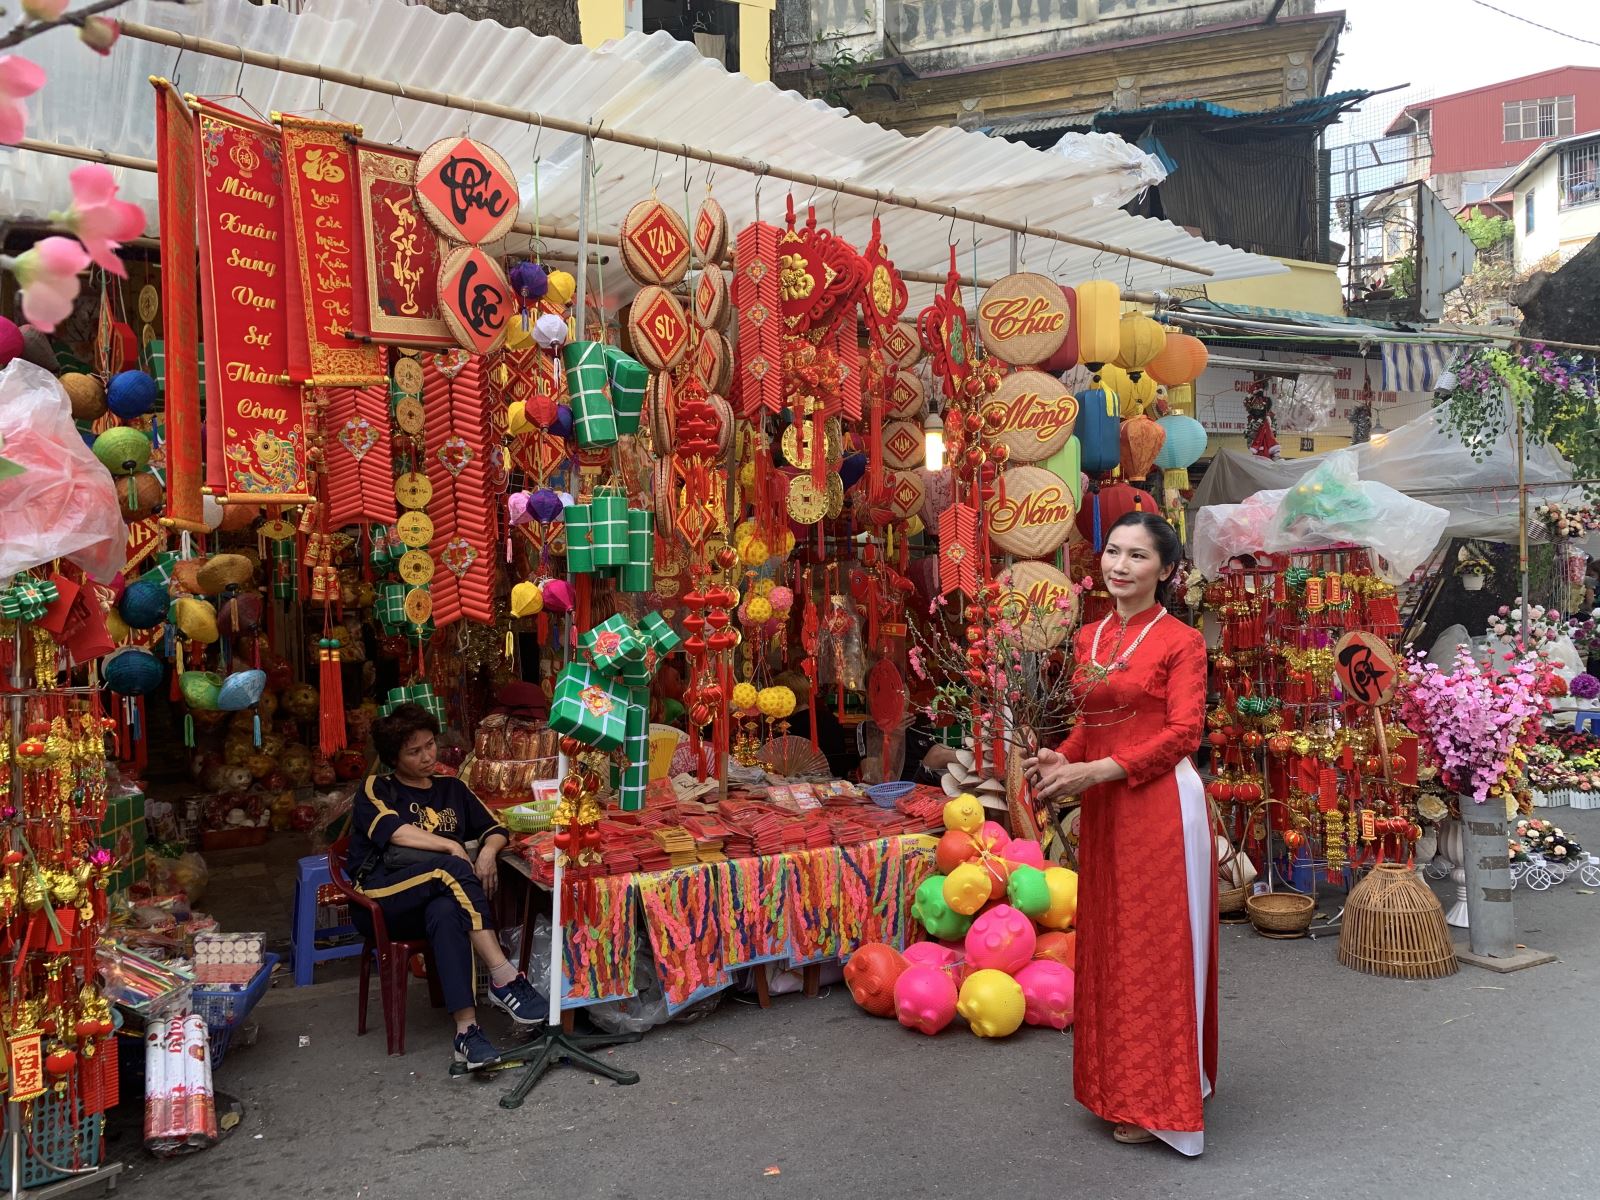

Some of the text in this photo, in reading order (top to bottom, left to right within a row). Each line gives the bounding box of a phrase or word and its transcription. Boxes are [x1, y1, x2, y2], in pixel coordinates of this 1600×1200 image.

[216, 176, 275, 208] Mừng
[219, 212, 277, 241] Xuân
[647, 226, 676, 264] VẠN
[226, 248, 277, 277] Sang
[231, 285, 277, 312] Vạn
[654, 313, 676, 347] SỰ
[981, 296, 1065, 342] Chúc
[243, 325, 273, 350] Sự
[237, 398, 288, 425] Công
[982, 394, 1079, 442] Mừng
[988, 486, 1072, 533] Năm
